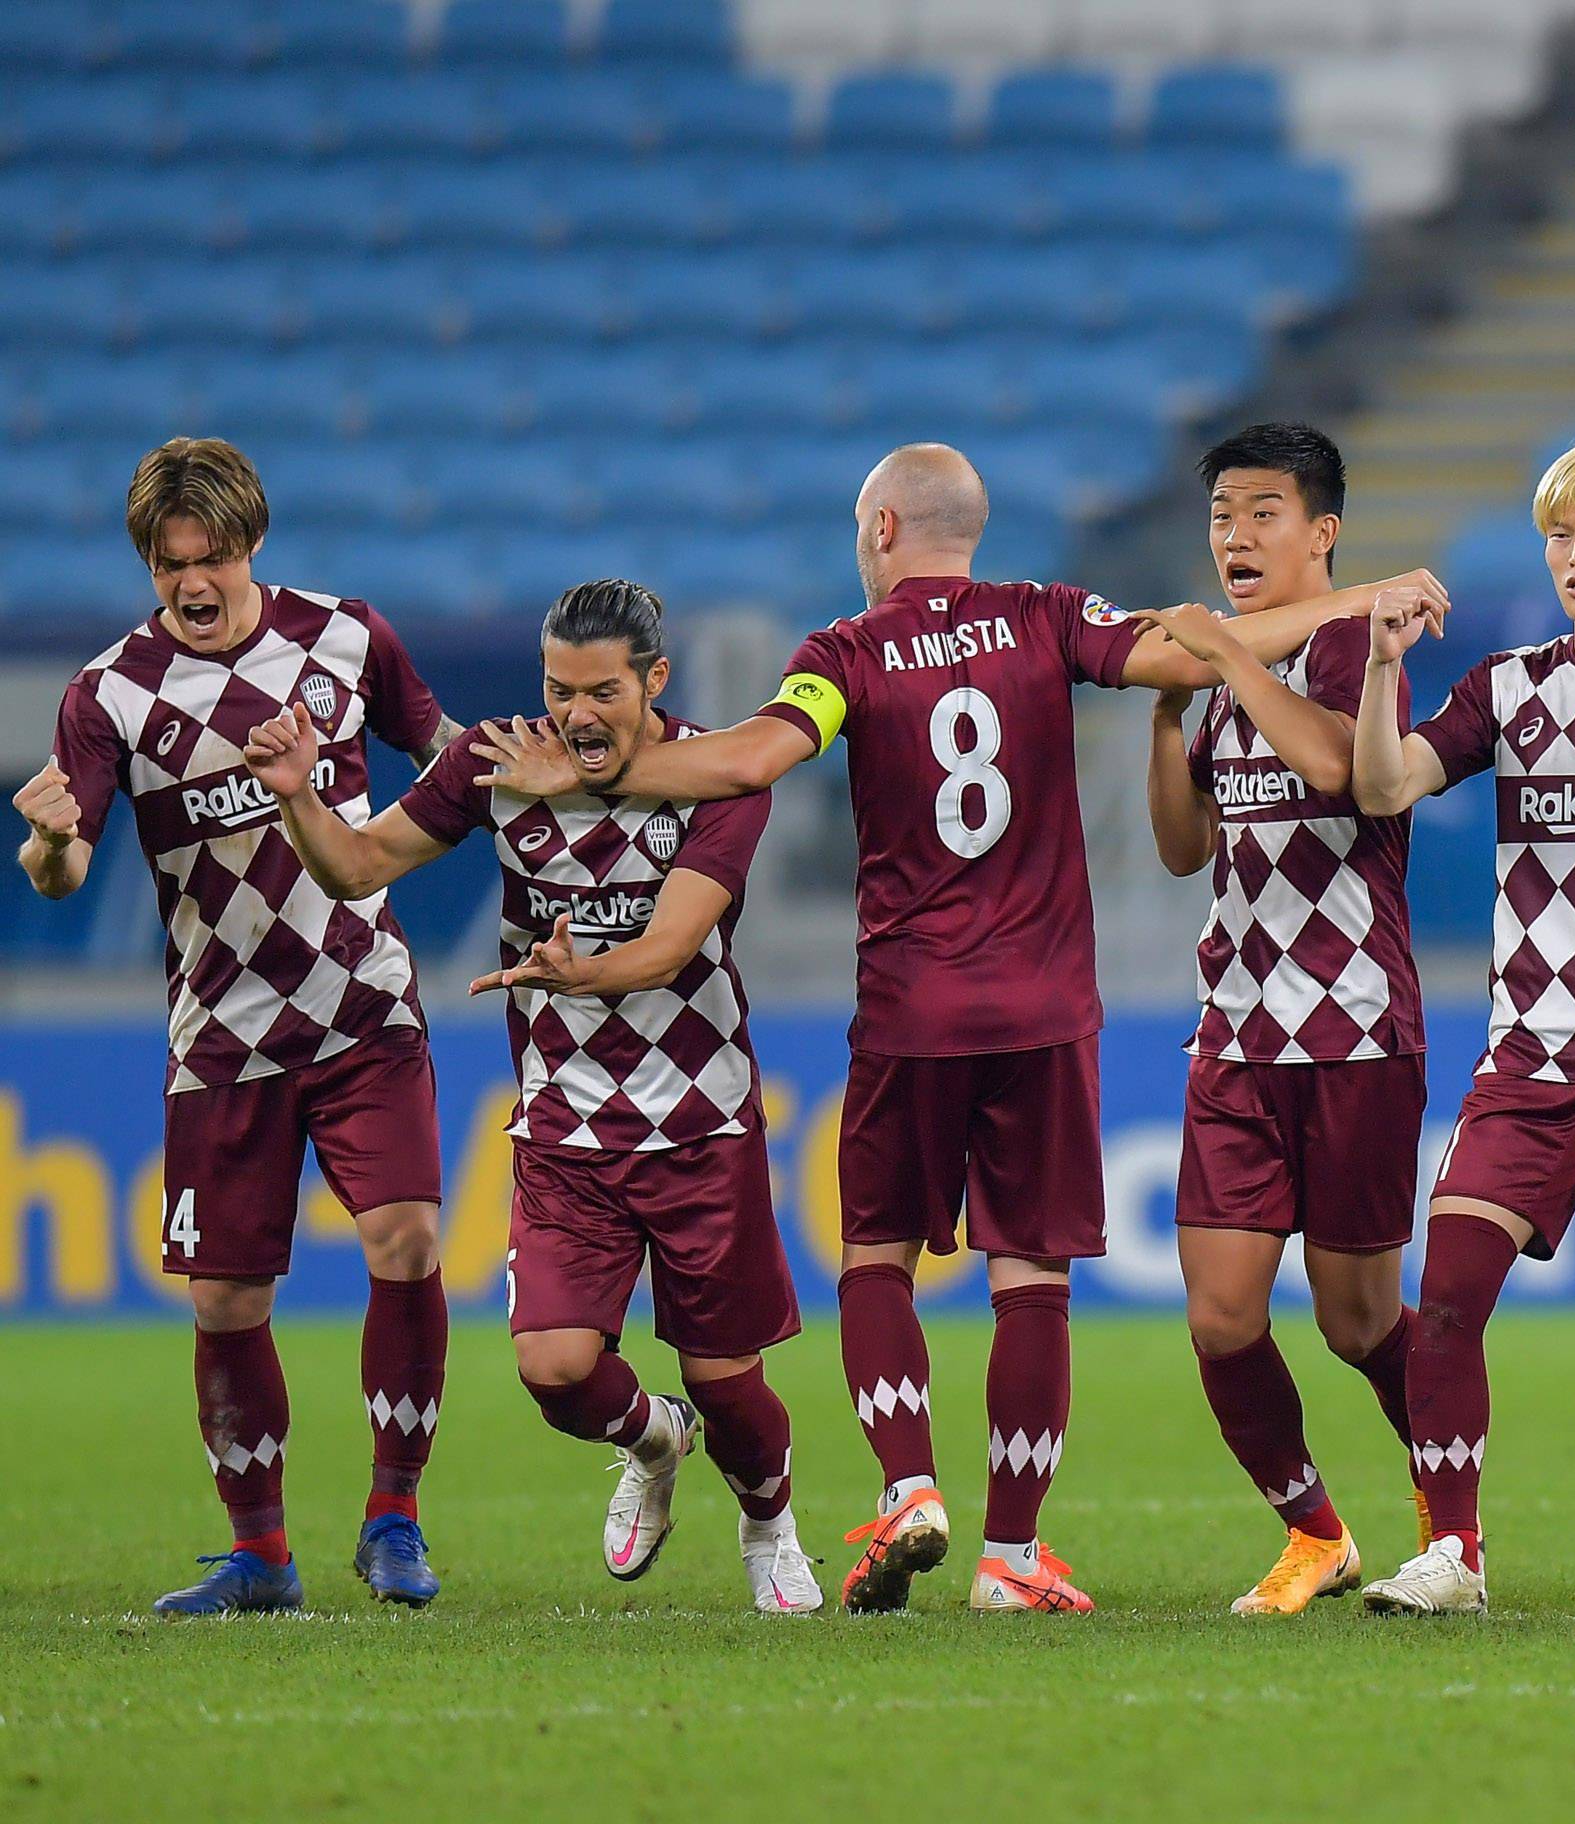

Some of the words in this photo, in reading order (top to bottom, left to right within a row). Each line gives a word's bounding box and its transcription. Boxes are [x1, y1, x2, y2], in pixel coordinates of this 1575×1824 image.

[883, 616, 1017, 672] A.INIESTA
[182, 758, 336, 825] Rakun
[929, 686, 1012, 860] 8
[1213, 765, 1306, 805] akuten
[527, 886, 659, 926] Rakute
[162, 1187, 200, 1258] 4
